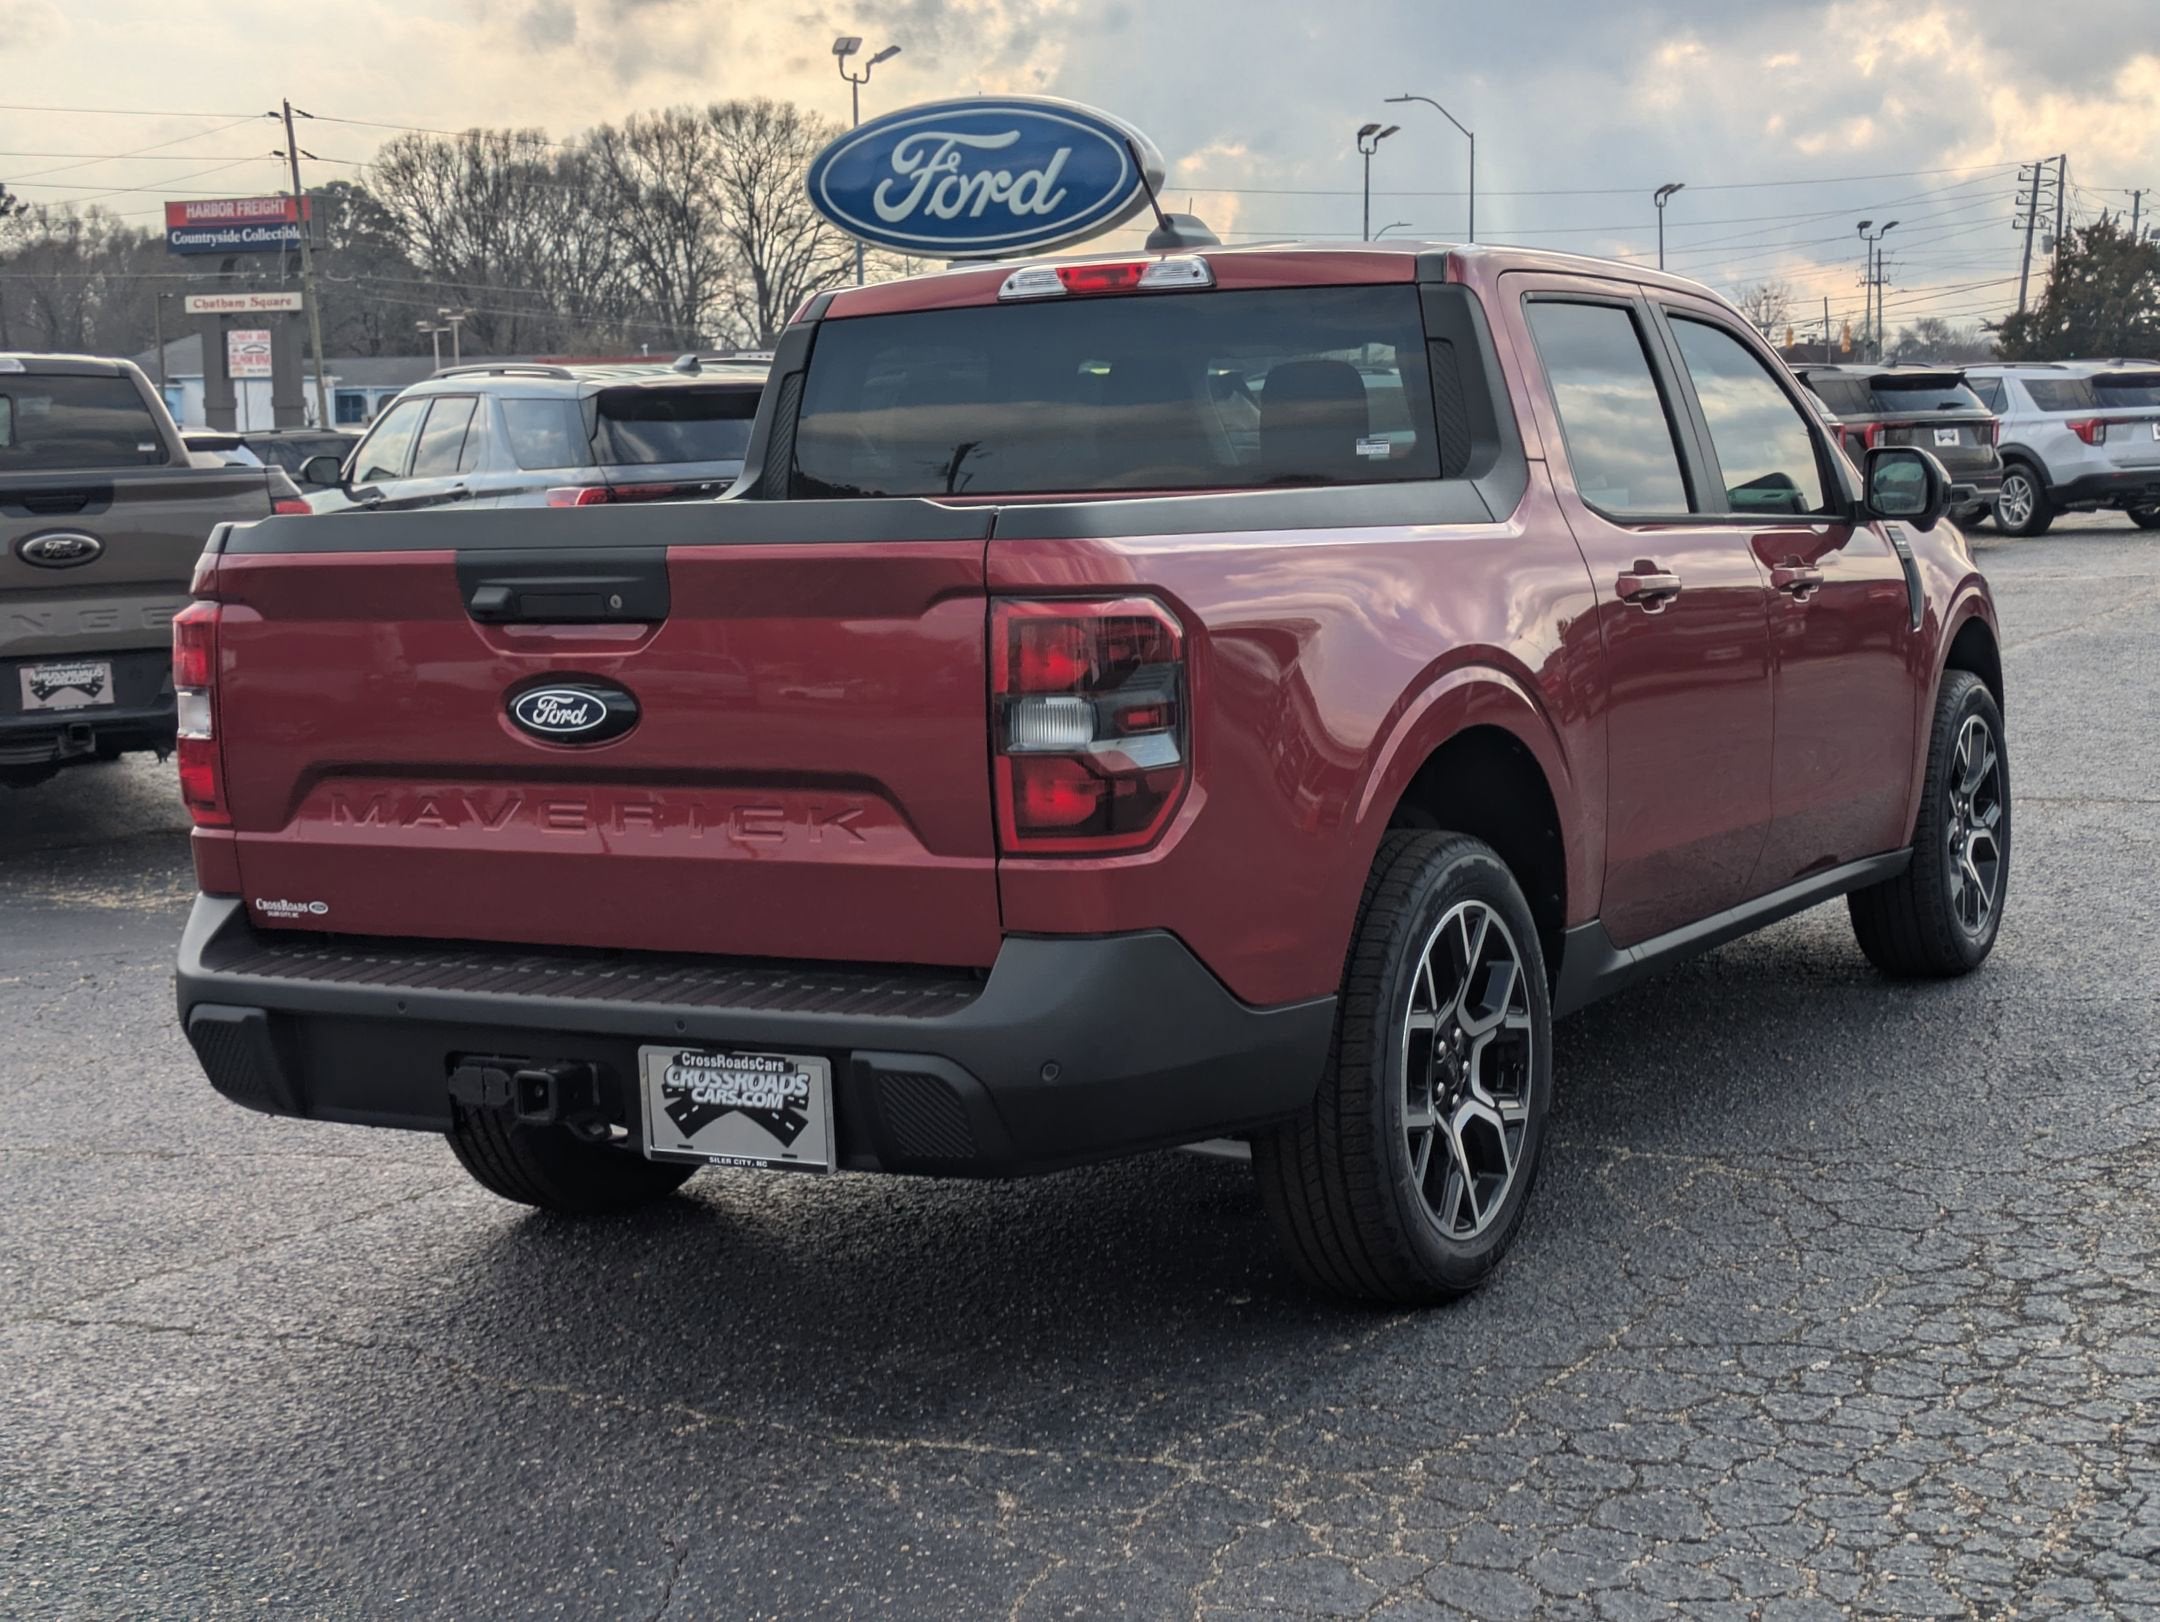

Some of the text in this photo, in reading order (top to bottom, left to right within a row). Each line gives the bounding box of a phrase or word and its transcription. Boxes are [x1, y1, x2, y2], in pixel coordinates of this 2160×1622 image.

[873, 130, 1072, 223] Ford
[186, 199, 286, 218] HARBOR FREIGHT
[172, 225, 308, 247] Countryside Collectible
[193, 296, 292, 309] Chatham Square
[41, 540, 85, 558] Ford
[532, 696, 588, 725] Ford
[330, 793, 866, 844] MAVERICK
[682, 1053, 785, 1073] CrossRoadsCars
[665, 1065, 810, 1097] CROSSROADS
[691, 1088, 785, 1110] CARS.COM
[709, 1156, 768, 1168] SILER CITY, NC
